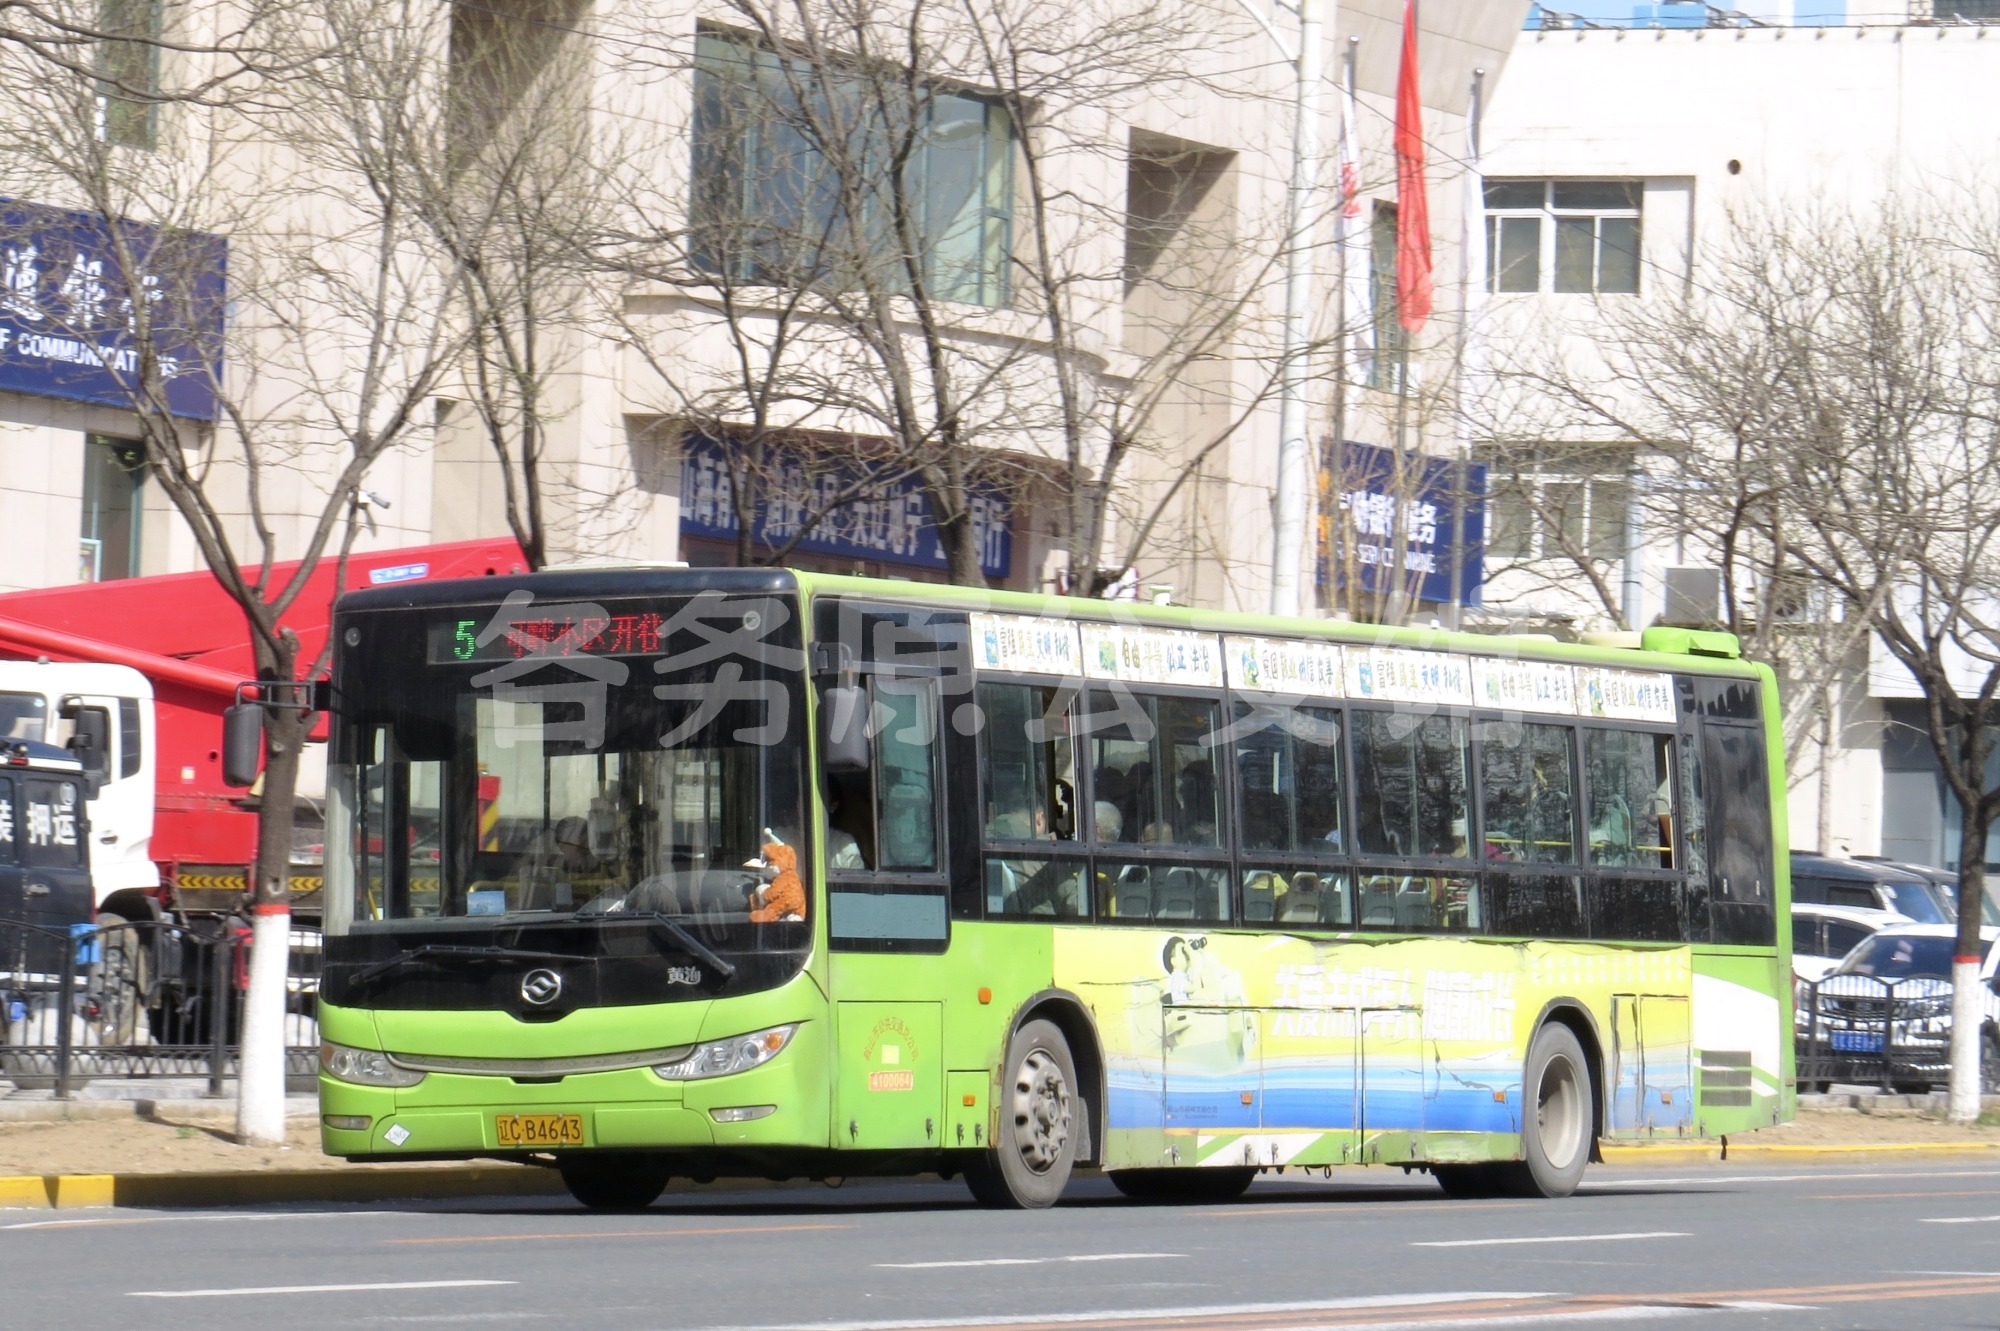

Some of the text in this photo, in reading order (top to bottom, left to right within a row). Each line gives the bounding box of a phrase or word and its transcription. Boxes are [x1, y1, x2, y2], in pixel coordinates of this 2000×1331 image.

[18, 333, 178, 379] COMMUNICATNS
[454, 621, 475, 660] 5
[667, 966, 701, 985] 黄海
